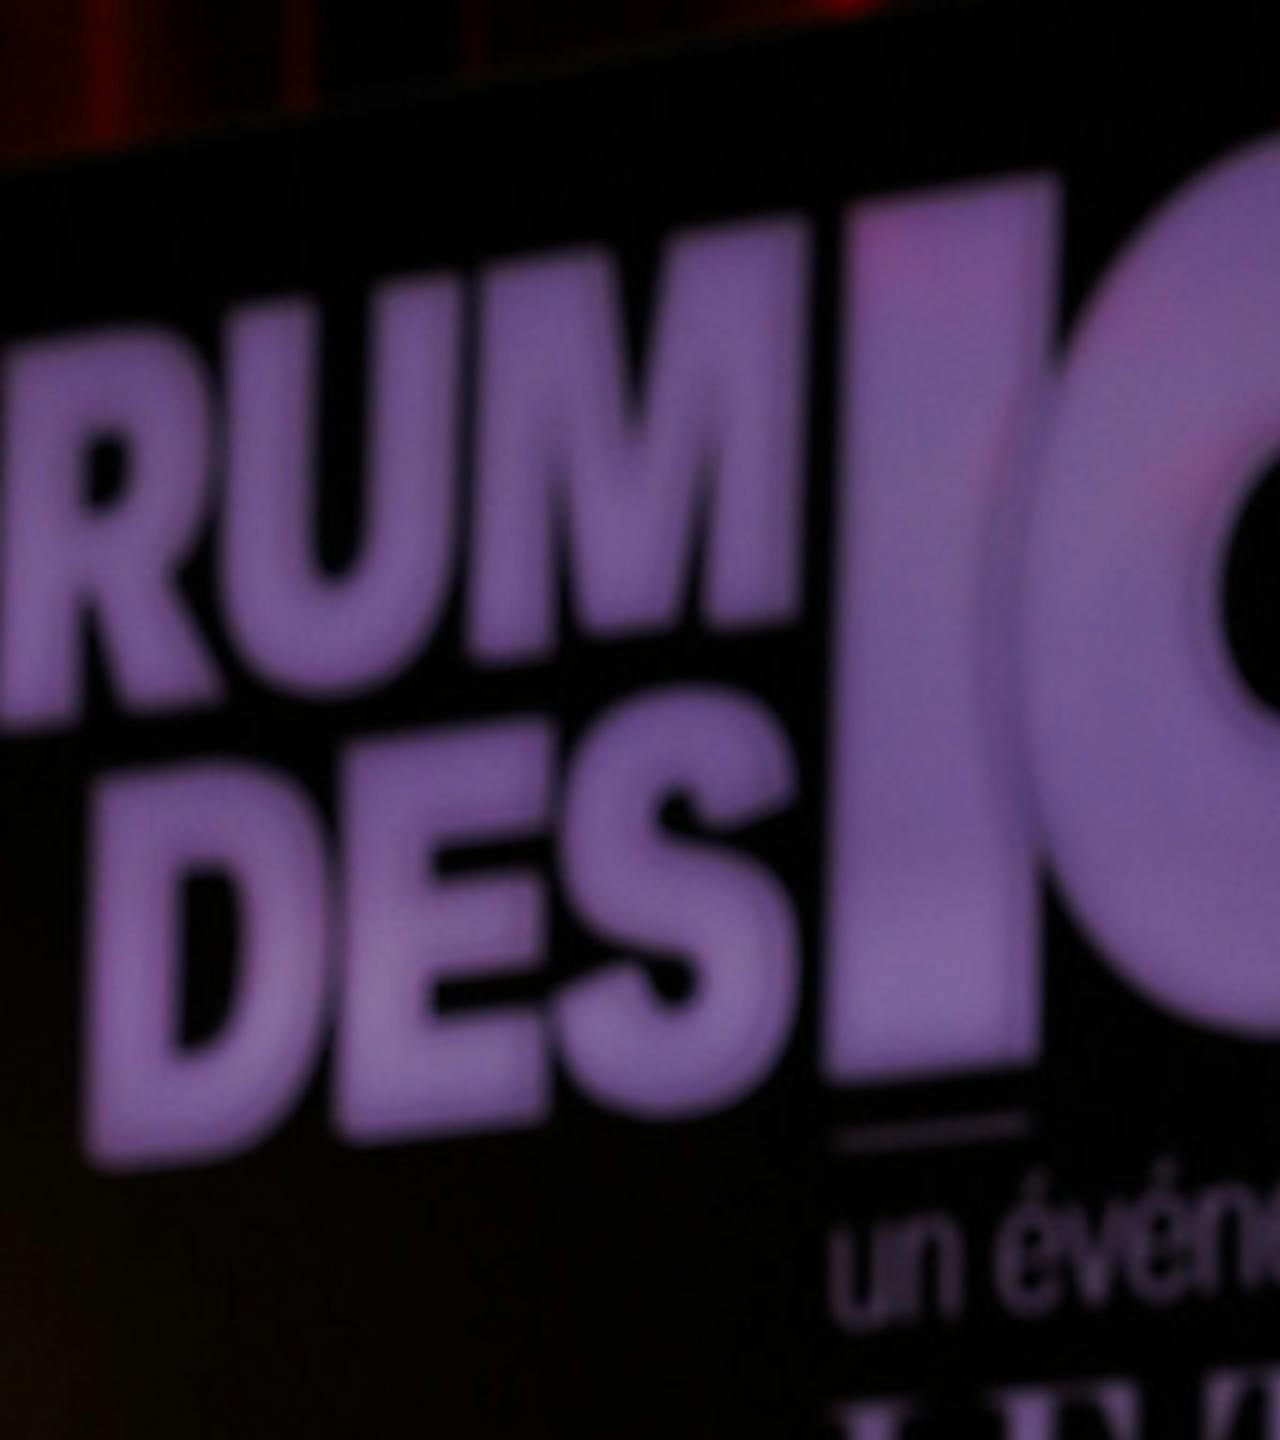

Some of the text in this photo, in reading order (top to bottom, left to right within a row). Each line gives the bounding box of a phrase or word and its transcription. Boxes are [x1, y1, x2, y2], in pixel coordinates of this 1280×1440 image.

[0, 219, 810, 730] RUM
[84, 686, 801, 1168] DES
[830, 1216, 960, 1326] un
